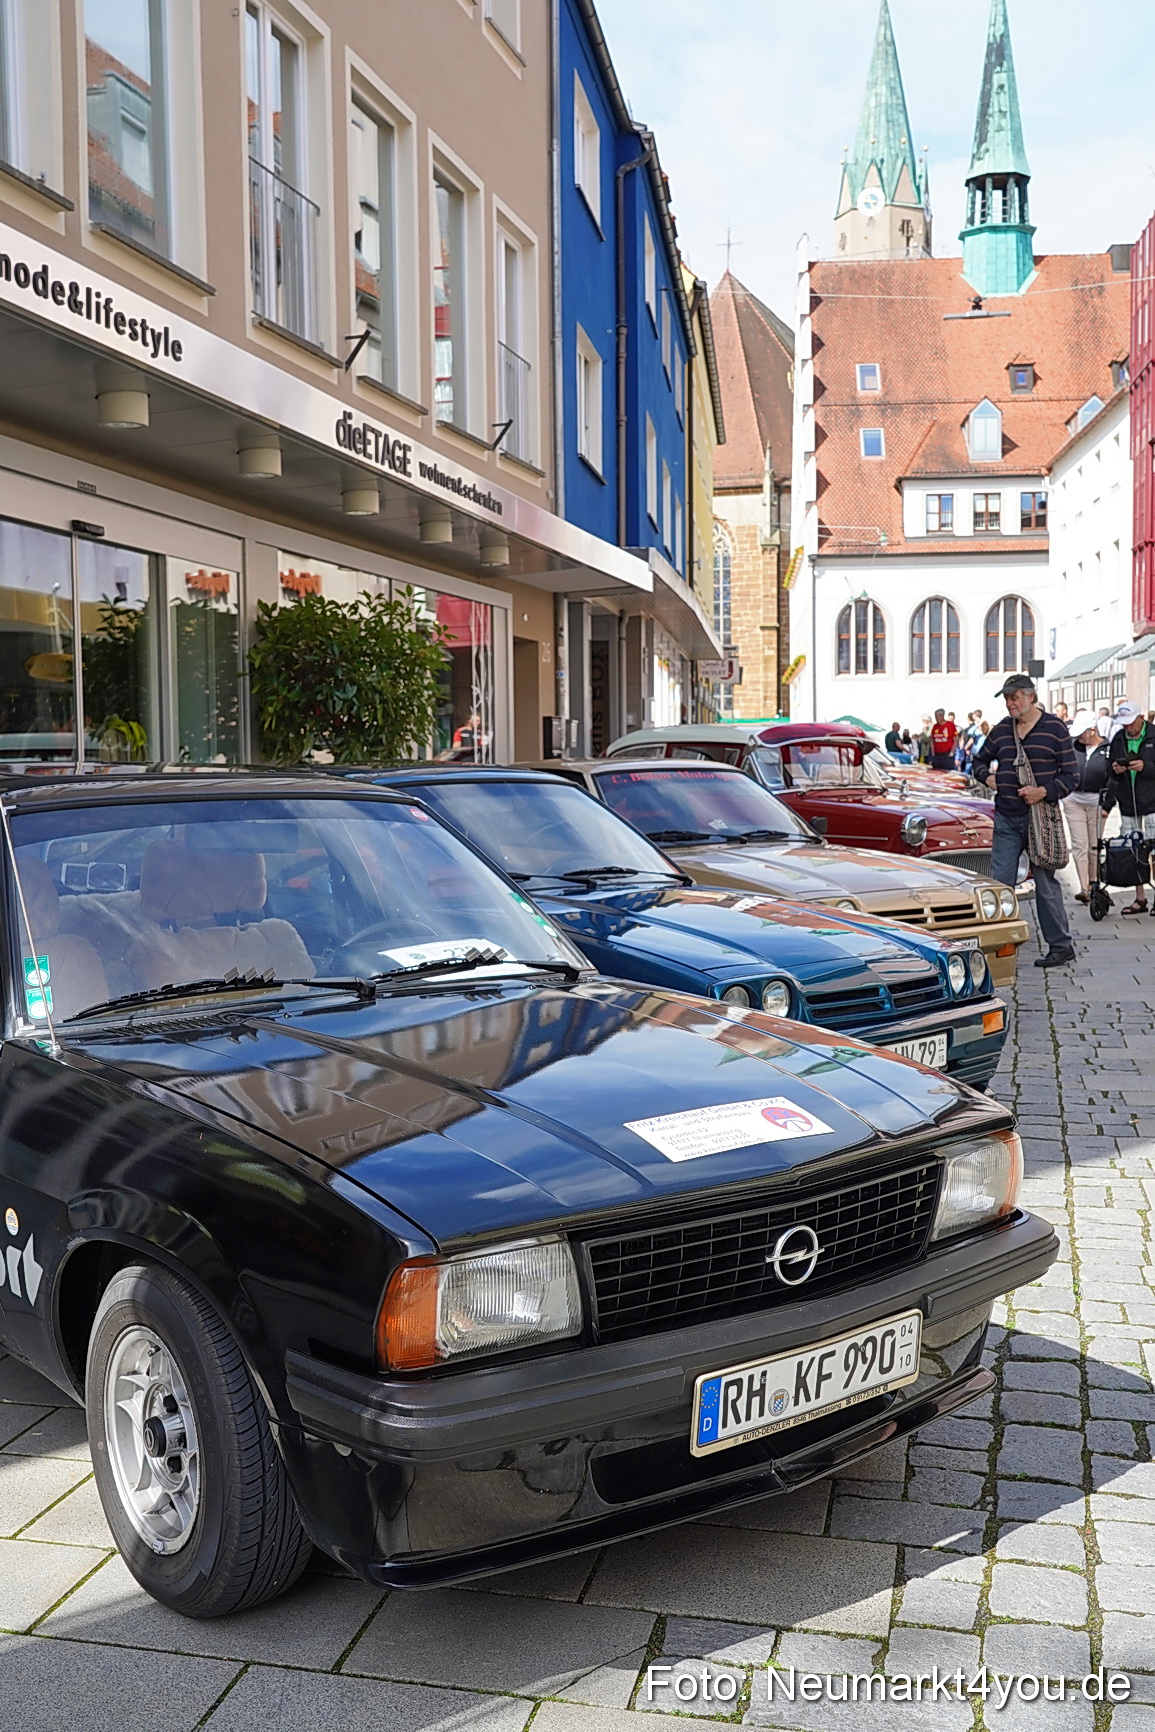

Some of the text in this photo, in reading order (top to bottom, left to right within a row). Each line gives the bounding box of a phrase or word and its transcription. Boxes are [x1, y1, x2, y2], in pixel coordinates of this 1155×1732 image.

[335, 410, 503, 516] dieETAGE wohnen&schenken
[918, 1040, 937, 1065] 79
[628, 1120, 655, 1130] Fritz
[707, 1102, 742, 1114] GmbH
[683, 1118, 701, 1127] und
[900, 1321, 914, 1337] 04
[899, 1354, 912, 1369] 10
[721, 1328, 897, 1430] RH KF 990
[702, 1417, 712, 1432] D
[741, 1420, 791, 1442] AUTO-DENZLER
